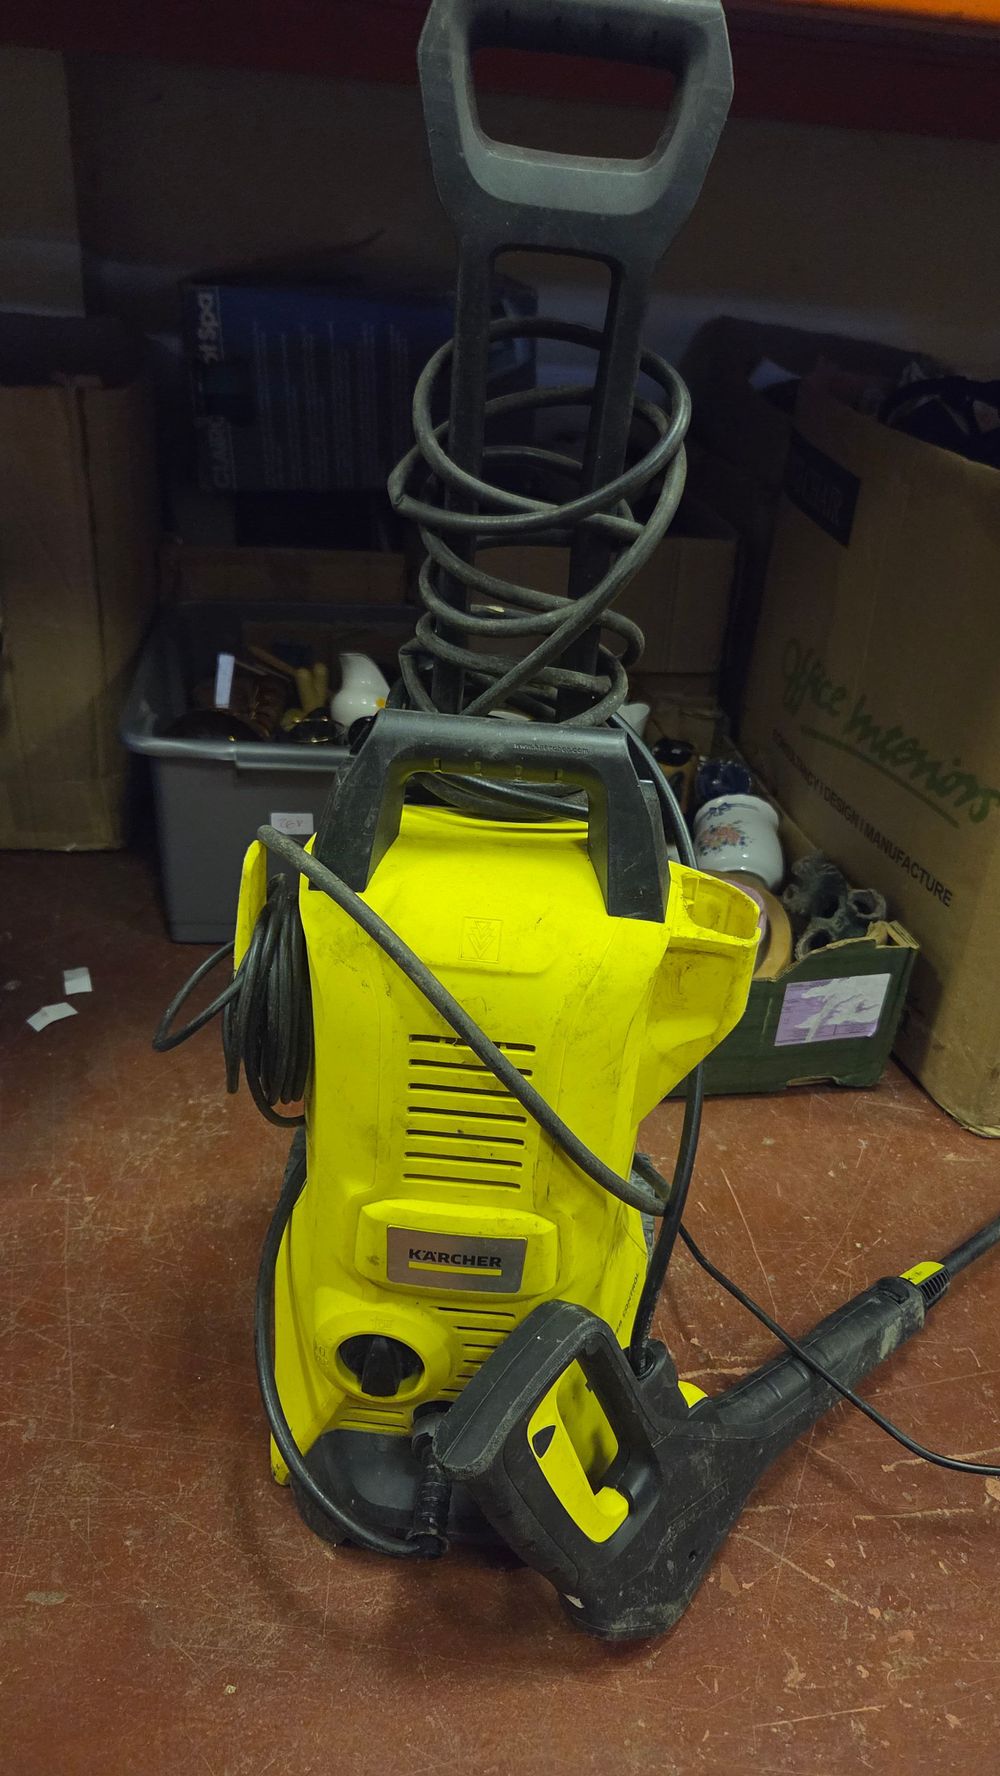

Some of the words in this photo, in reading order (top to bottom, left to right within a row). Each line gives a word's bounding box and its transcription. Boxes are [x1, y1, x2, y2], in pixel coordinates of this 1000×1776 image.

[783, 638, 847, 717] Office
[823, 786, 859, 829] DESIGN
[863, 822, 953, 908] MANUFACTURE
[408, 1248, 502, 1267] KÄRCHER
